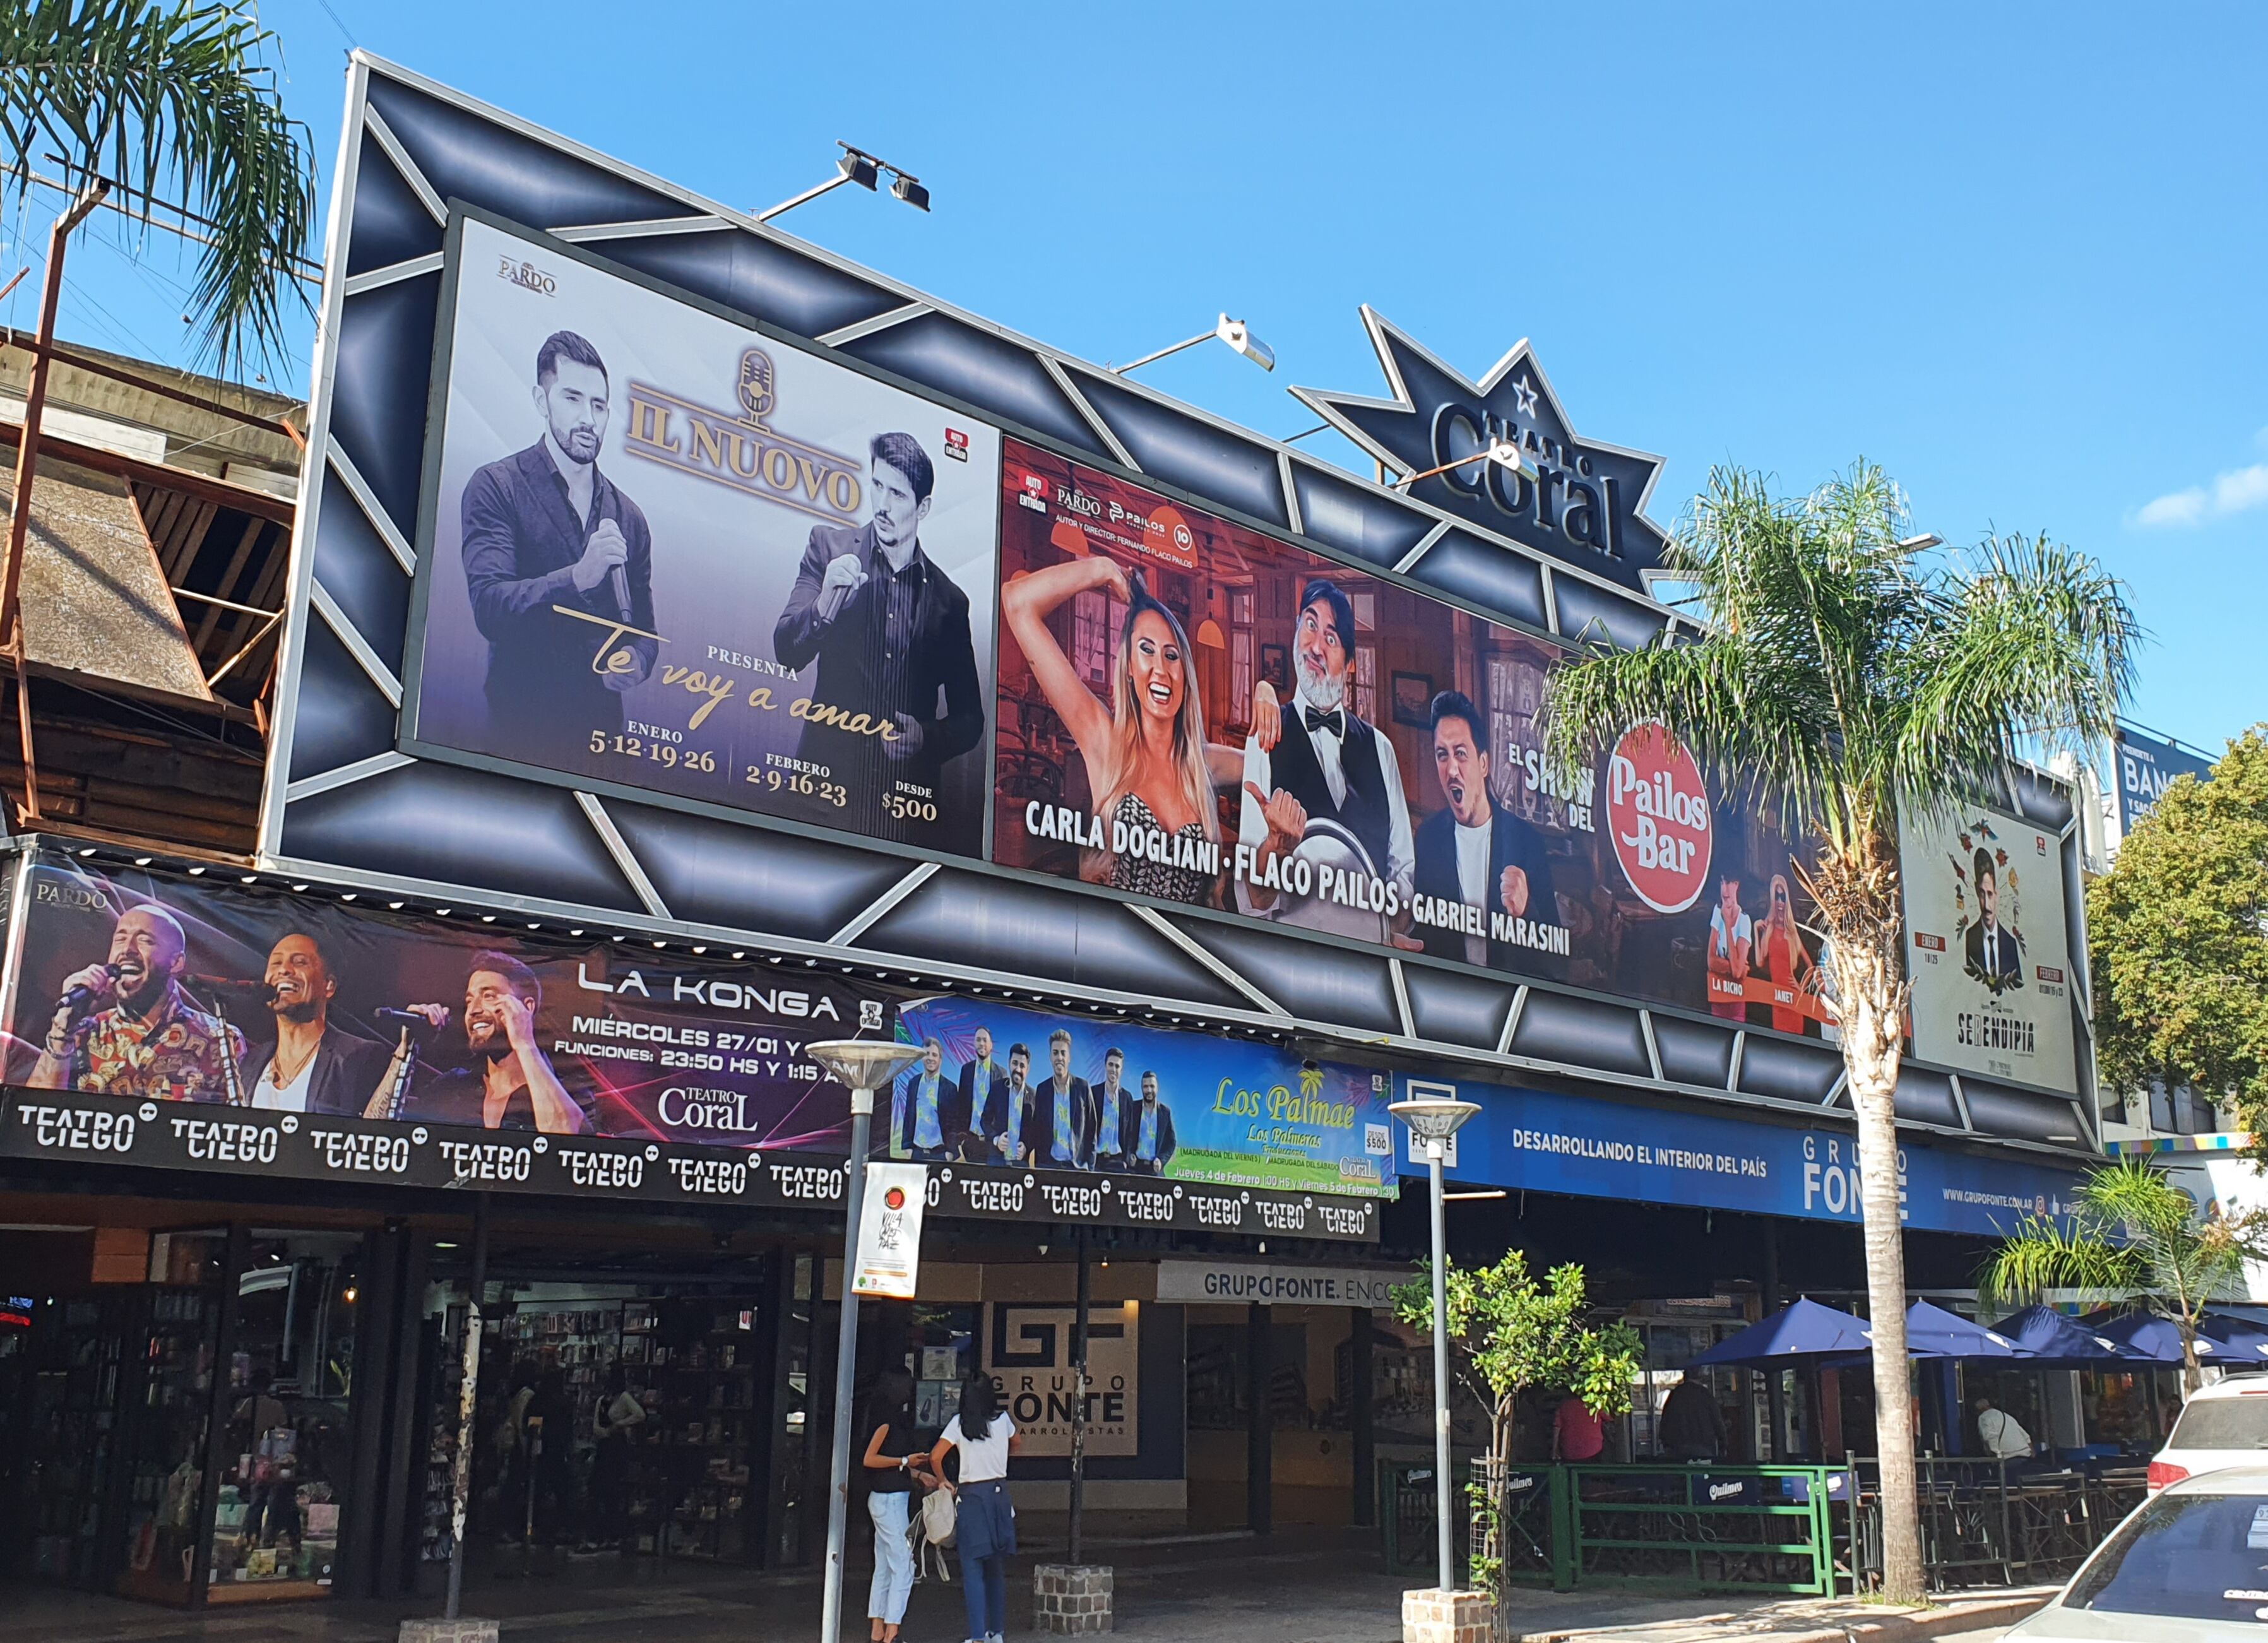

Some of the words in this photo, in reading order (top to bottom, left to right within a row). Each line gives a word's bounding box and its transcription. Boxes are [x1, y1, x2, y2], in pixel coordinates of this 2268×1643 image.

[499, 259, 555, 293] PARDO
[631, 397, 678, 453] IL
[689, 418, 861, 513] NUOVO
[1483, 410, 1594, 477] TEATRO
[1025, 475, 1042, 490] AUTO
[1431, 401, 1624, 562] Coral
[1057, 487, 1101, 515] PARDO
[1055, 514, 1078, 529] AUTOR
[1078, 521, 1083, 530] Y
[1084, 524, 1117, 542] DIRECTOR:
[1117, 535, 1151, 555] FERNANDO
[1151, 547, 1172, 562] FLACO
[1172, 556, 1193, 569] PAILOS
[1177, 529, 1189, 545] 10
[552, 604, 671, 675] Te
[661, 660, 735, 730] voy
[747, 686, 778, 711] a
[789, 697, 900, 742] amar
[707, 644, 799, 682] PRESENTA
[627, 720, 683, 744] ENERO
[766, 752, 831, 778] FEBRERO
[1509, 742, 1524, 766] EL
[1525, 749, 1594, 807] SHOW
[895, 780, 933, 798] DESDE
[1611, 754, 1707, 831] Pailos
[881, 791, 937, 821] $500
[2127, 797, 2134, 810] Y
[1569, 802, 1595, 833] DEL
[1620, 814, 1696, 875] Bar
[1025, 800, 1105, 851] CARLA
[1112, 819, 1219, 877] DOGLIANI
[1235, 842, 1312, 896] FLACO
[1318, 863, 1399, 917] PAILOS
[1412, 892, 1487, 939] GABRIEL
[1490, 910, 1572, 957] MARASINI
[36, 884, 107, 910] PARDO
[578, 963, 650, 999] LA
[673, 976, 840, 1021] KONGA
[1712, 977, 1721, 991] LA
[1723, 980, 1743, 997] BICHO
[1774, 988, 1795, 1005] JANET
[572, 1012, 710, 1047] MIÉRCOLES
[716, 1033, 779, 1056] 27/01
[784, 1040, 801, 1057] Y
[1958, 1012, 2034, 1053] SERENDIPIA
[554, 1040, 654, 1062] FUNCIONES:
[660, 1050, 724, 1072] 23:50
[729, 1058, 759, 1076] HS
[766, 1060, 781, 1077] Y
[788, 1063, 818, 1081] 1:15
[686, 1086, 738, 1104] TEATRO
[1211, 1076, 1262, 1117] Los
[18, 1105, 134, 1134] TEATRO
[37, 1125, 134, 1152] CIEGO
[170, 1118, 278, 1145] TEATRO
[310, 1130, 410, 1156] TEATRO
[1246, 1123, 1268, 1142] Los
[1271, 1126, 1322, 1149] Palmeras
[1366, 1137, 1386, 1149] $500
[1367, 1130, 1385, 1139] DESDE
[188, 1138, 277, 1163] CIEGO
[326, 1149, 409, 1173] CIEGO
[439, 1141, 531, 1164] TEATRO
[558, 1150, 643, 1171] TEATRO
[1223, 1152, 1233, 1160] DEL
[1235, 1154, 1261, 1164] VIERNES)
[1512, 1128, 1634, 1163] DESARROLLANDO
[1637, 1145, 1653, 1165] EL
[1655, 1147, 1714, 1171] INTERIOR
[1716, 1155, 1738, 1175] DEL
[1740, 1156, 1767, 1178] PAÍS
[1803, 1136, 1908, 1173] GRUO
[454, 1160, 530, 1181] CIEGO
[572, 1167, 643, 1188] CIEGO
[668, 1158, 747, 1179] TEATRO
[769, 1165, 843, 1185] TEATRO
[680, 1174, 746, 1195] CIEGO
[781, 1181, 842, 1200] CIEGO
[959, 1179, 1023, 1197] TEATRO
[1174, 1166, 1205, 1180] Jueves
[1206, 1170, 1213, 1180] 4
[1214, 1170, 1226, 1180] de
[1227, 1171, 1261, 1185] Febrero
[1299, 1179, 1328, 1191] Viernes
[1330, 1182, 1336, 1191] 5
[1337, 1182, 1347, 1193] de
[1347, 1183, 1379, 1196] Febrero
[971, 1194, 1023, 1213] CIEGO
[1041, 1185, 1101, 1202] TEATRO
[1117, 1190, 1173, 1207] TEATRO
[1188, 1195, 1242, 1213] TEATRO
[1052, 1199, 1101, 1217] CIEGO
[1127, 1204, 1173, 1222] CIEGO
[1198, 1209, 1242, 1226] CIEGO
[1255, 1201, 1305, 1217] TEATRO
[1317, 1206, 1365, 1222] TEATRO
[1264, 1213, 1305, 1231] CIEGO
[1326, 1218, 1365, 1235] CIEGO
[1509, 1477, 1533, 1490] uilmes
[1709, 1481, 1743, 1501] Quilmes
